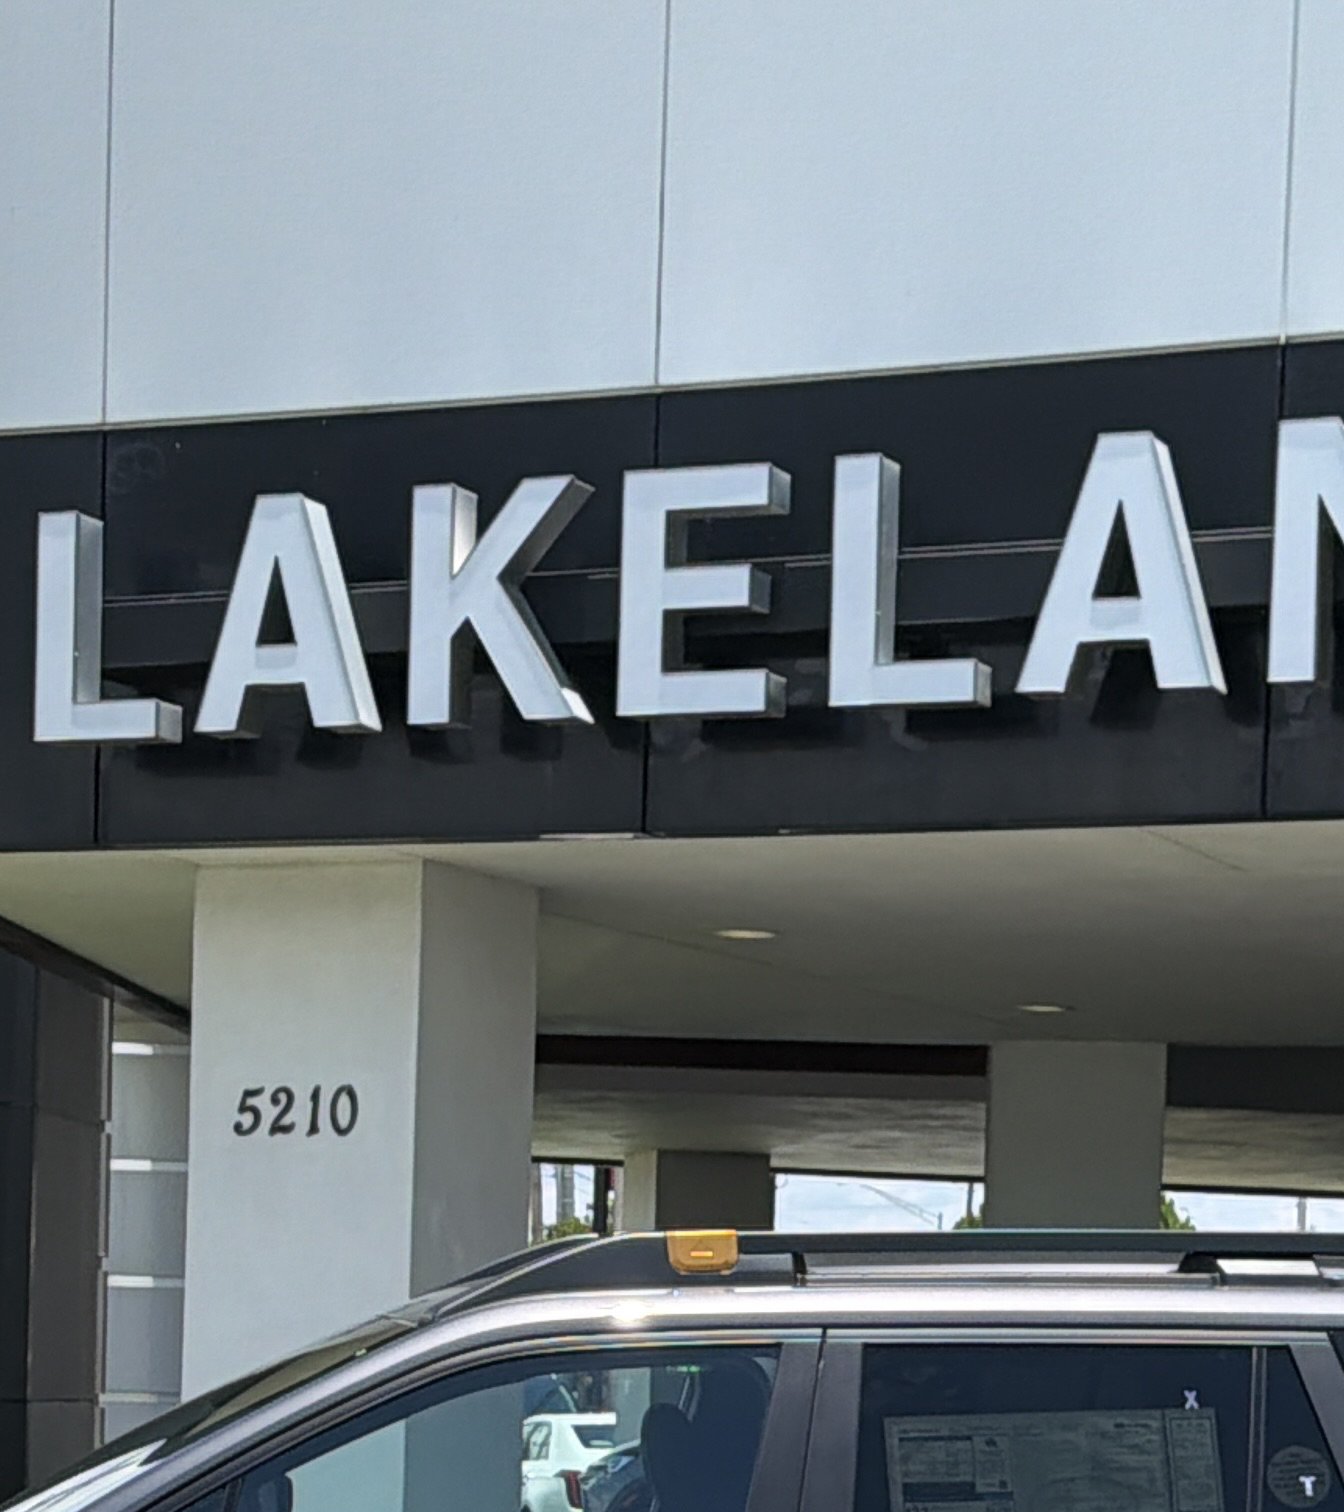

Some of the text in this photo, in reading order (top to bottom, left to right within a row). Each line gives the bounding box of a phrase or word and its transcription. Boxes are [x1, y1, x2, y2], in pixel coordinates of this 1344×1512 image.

[232, 1083, 359, 1137] 5210
[1182, 1389, 1200, 1410] X
[1298, 1475, 1317, 1497] T
